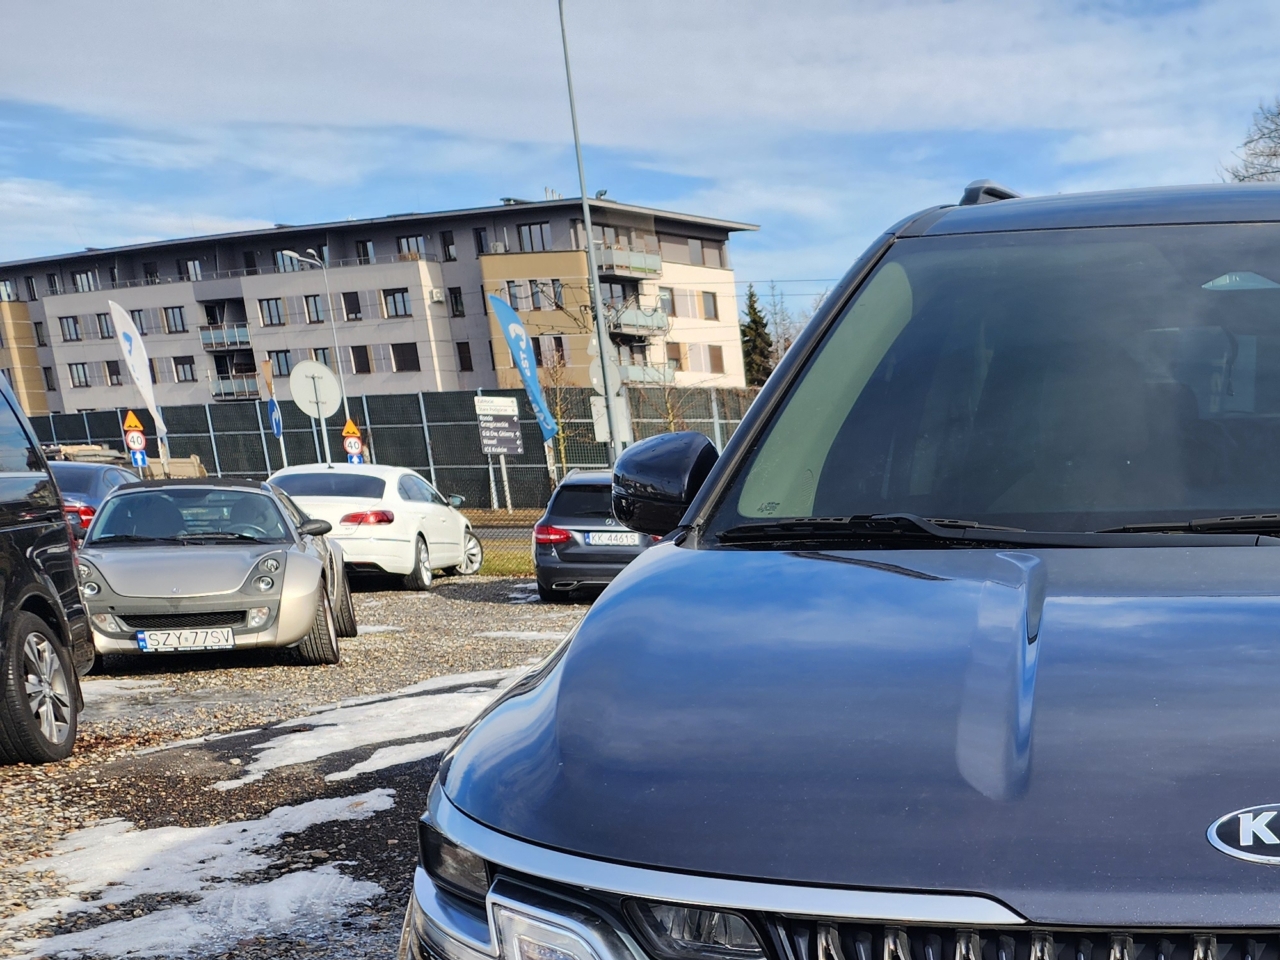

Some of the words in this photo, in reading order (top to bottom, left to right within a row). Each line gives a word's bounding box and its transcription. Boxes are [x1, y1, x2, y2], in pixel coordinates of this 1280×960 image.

[129, 435, 143, 446] 40
[347, 440, 360, 451] 40
[591, 533, 604, 543] KK
[607, 533, 636, 544] 4461S
[148, 632, 183, 647] SZY
[189, 630, 230, 645] 77SV
